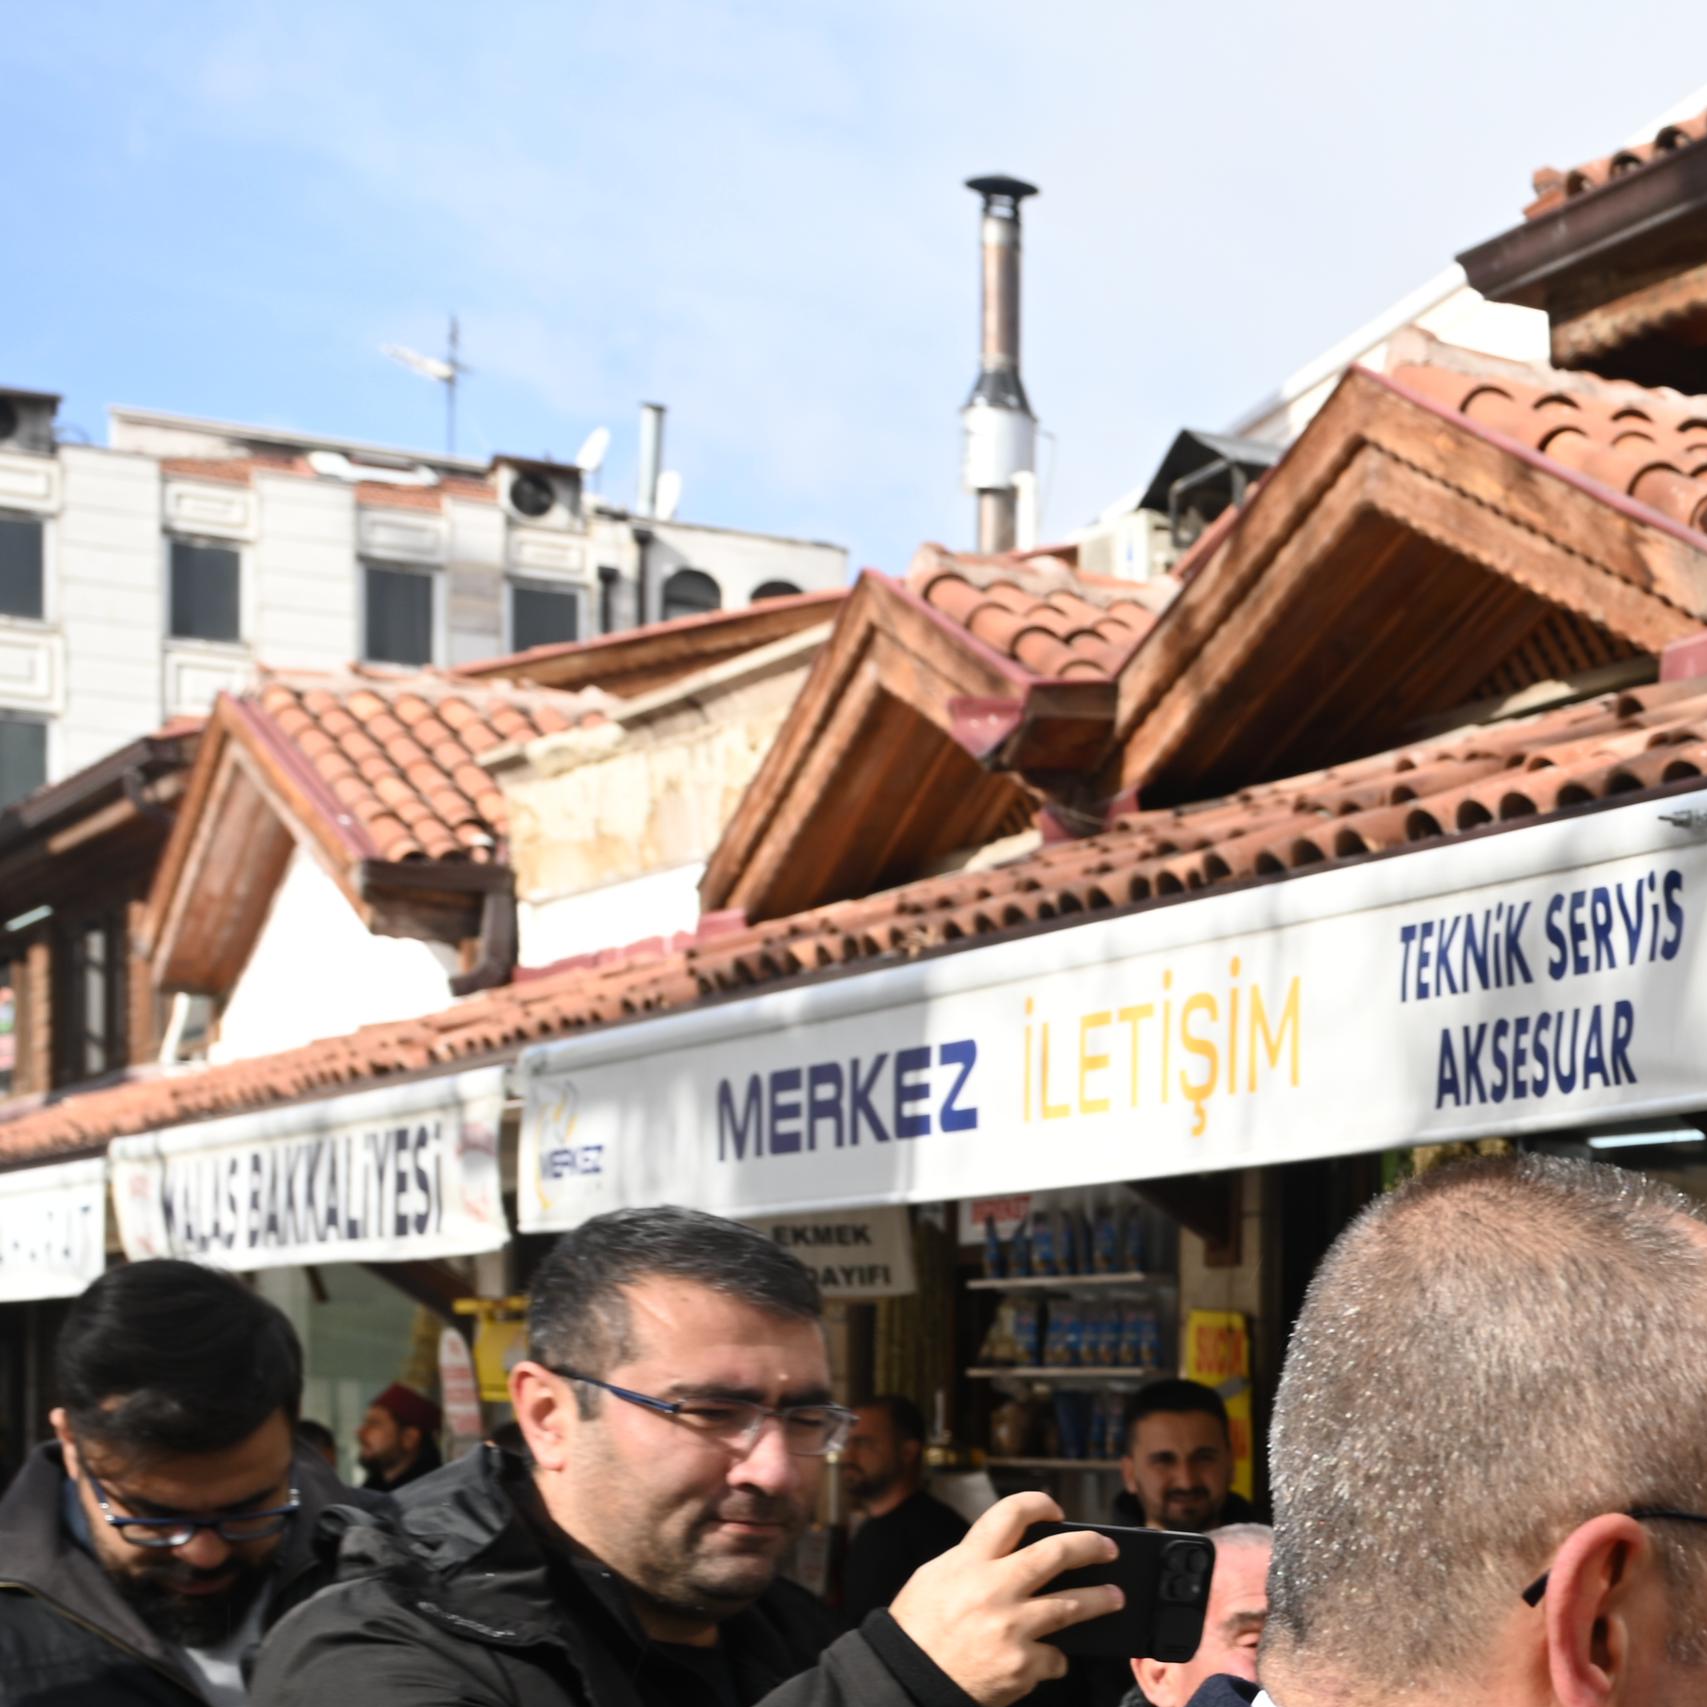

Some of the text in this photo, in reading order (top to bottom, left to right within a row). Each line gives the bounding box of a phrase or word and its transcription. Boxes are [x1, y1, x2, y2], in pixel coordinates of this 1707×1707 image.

[717, 956, 1301, 1161] MERKEZ İLETİŞİM
[1435, 1000, 1638, 1109] AKSESUAR
[772, 1223, 871, 1246] EKMEK
